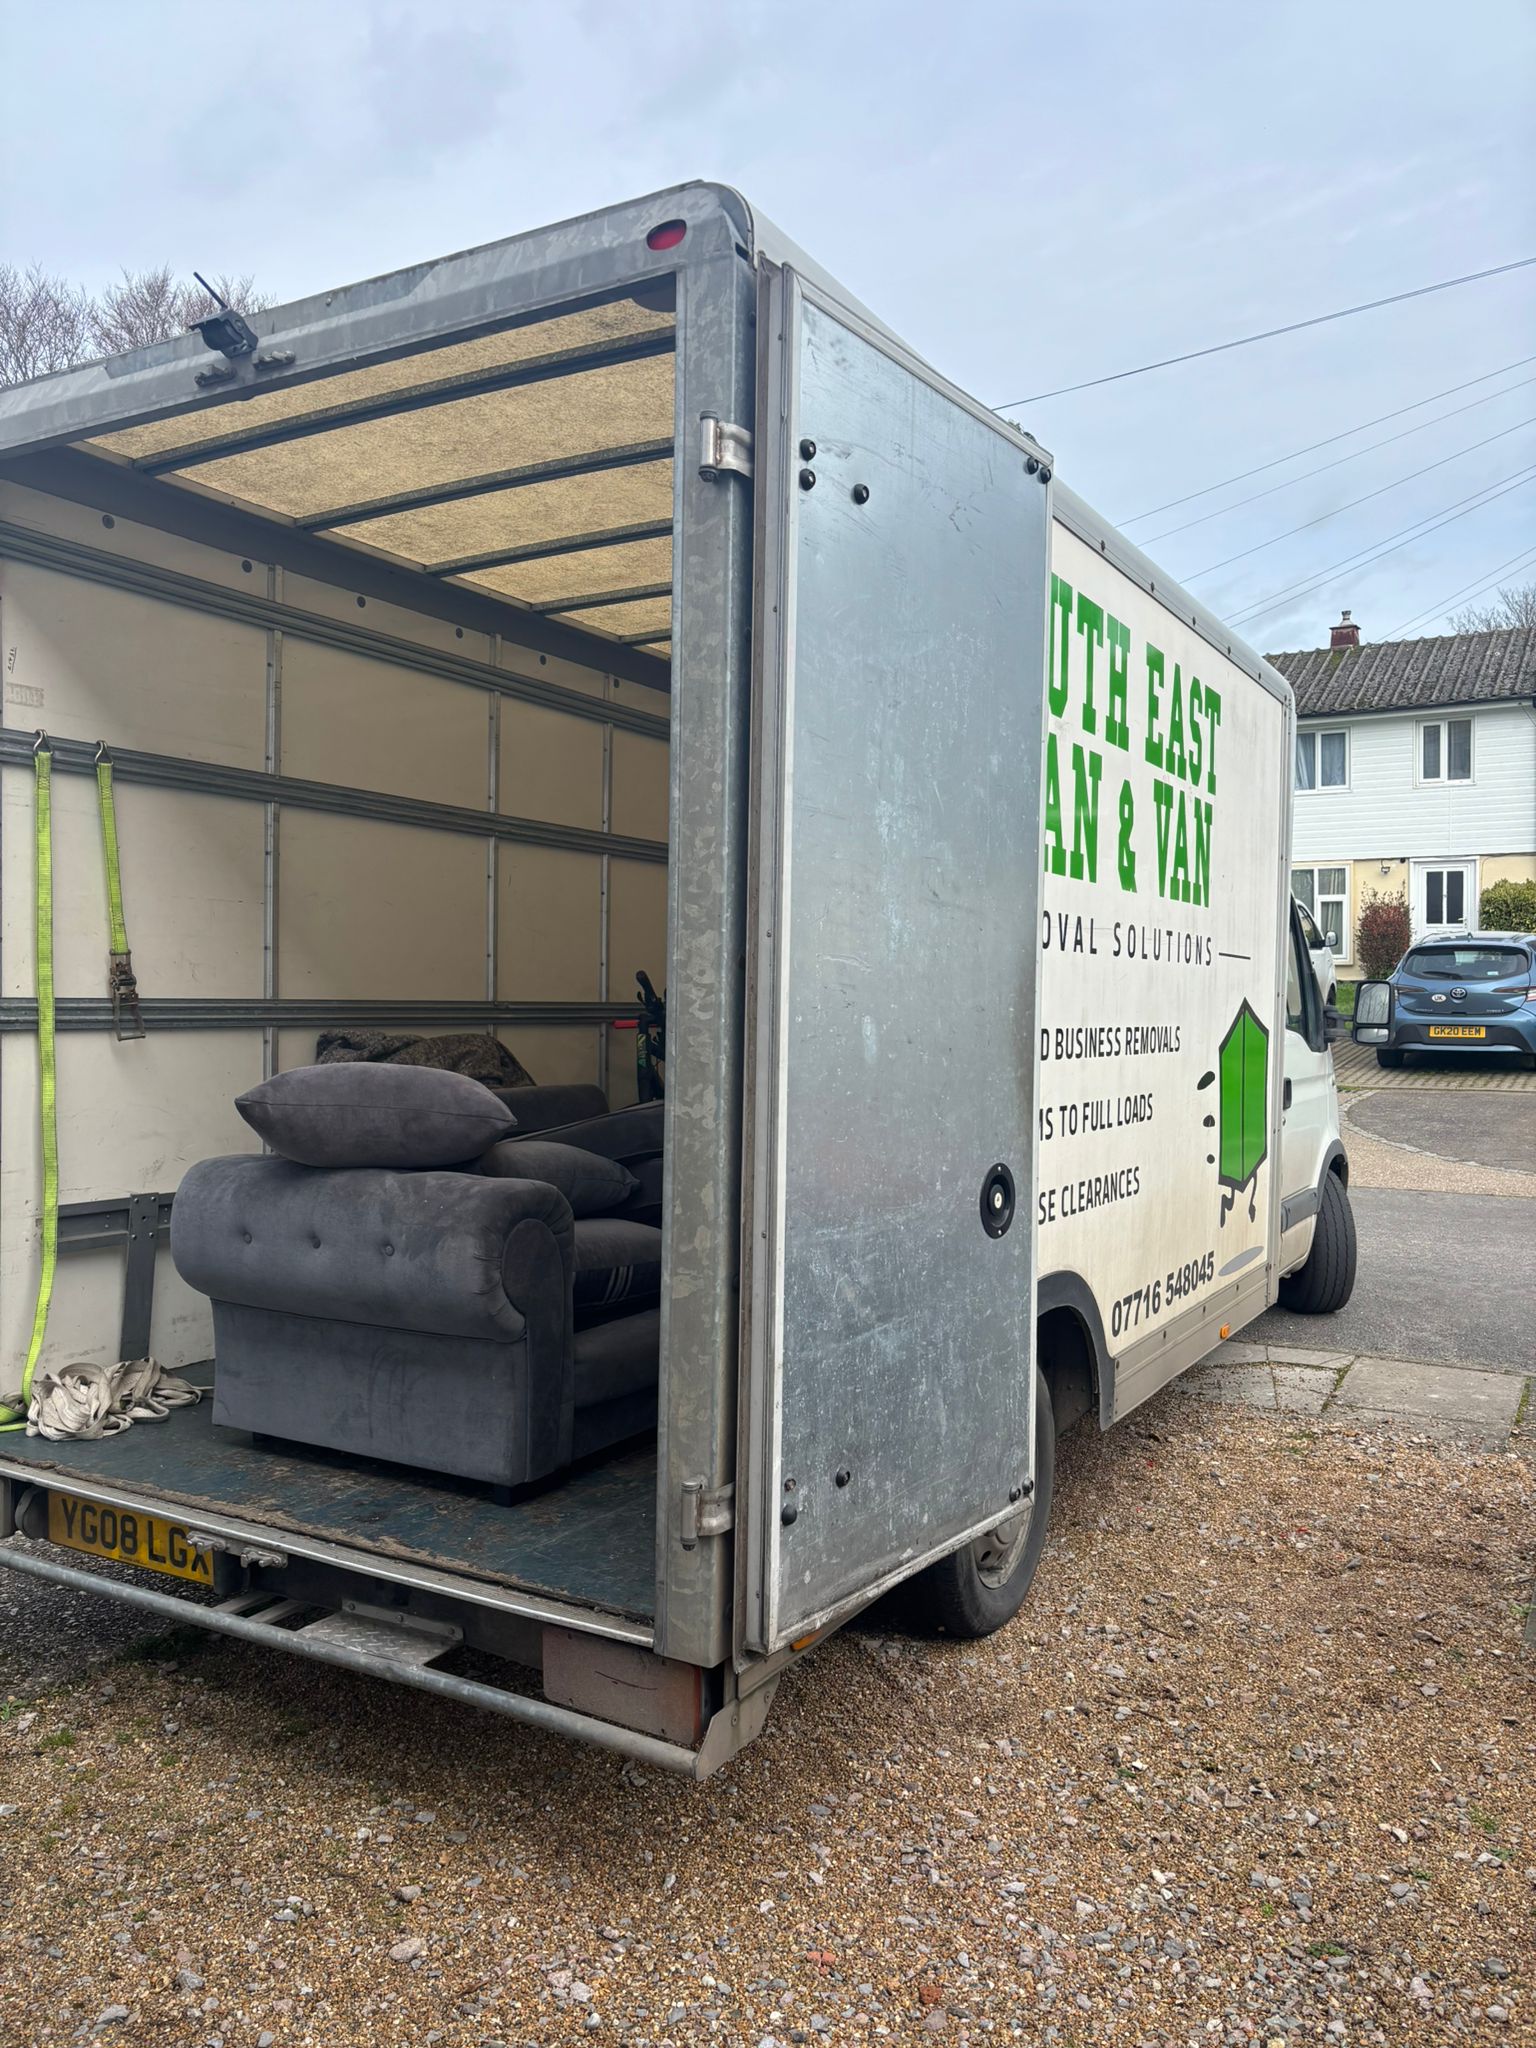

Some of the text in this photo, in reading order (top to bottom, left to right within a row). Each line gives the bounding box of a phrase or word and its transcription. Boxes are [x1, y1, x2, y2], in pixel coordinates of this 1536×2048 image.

[1048, 572, 1221, 796] UTH EAST
[1118, 779, 1137, 894] &
[1153, 778, 1213, 908] VAN
[1042, 910, 1212, 966] OVAL SOLUTIONS
[1040, 1026, 1181, 1061] D BUSINESS REMOVALS
[1434, 1026, 1480, 1036] GK20 EEM
[1059, 1104, 1078, 1137] TO
[1082, 1100, 1113, 1133] FULL
[1117, 1093, 1153, 1127] LOADS
[1038, 1166, 1140, 1226] SE CLEARANCES
[1111, 1250, 1214, 1338] 07716 548045
[61, 1498, 138, 1555] YG08
